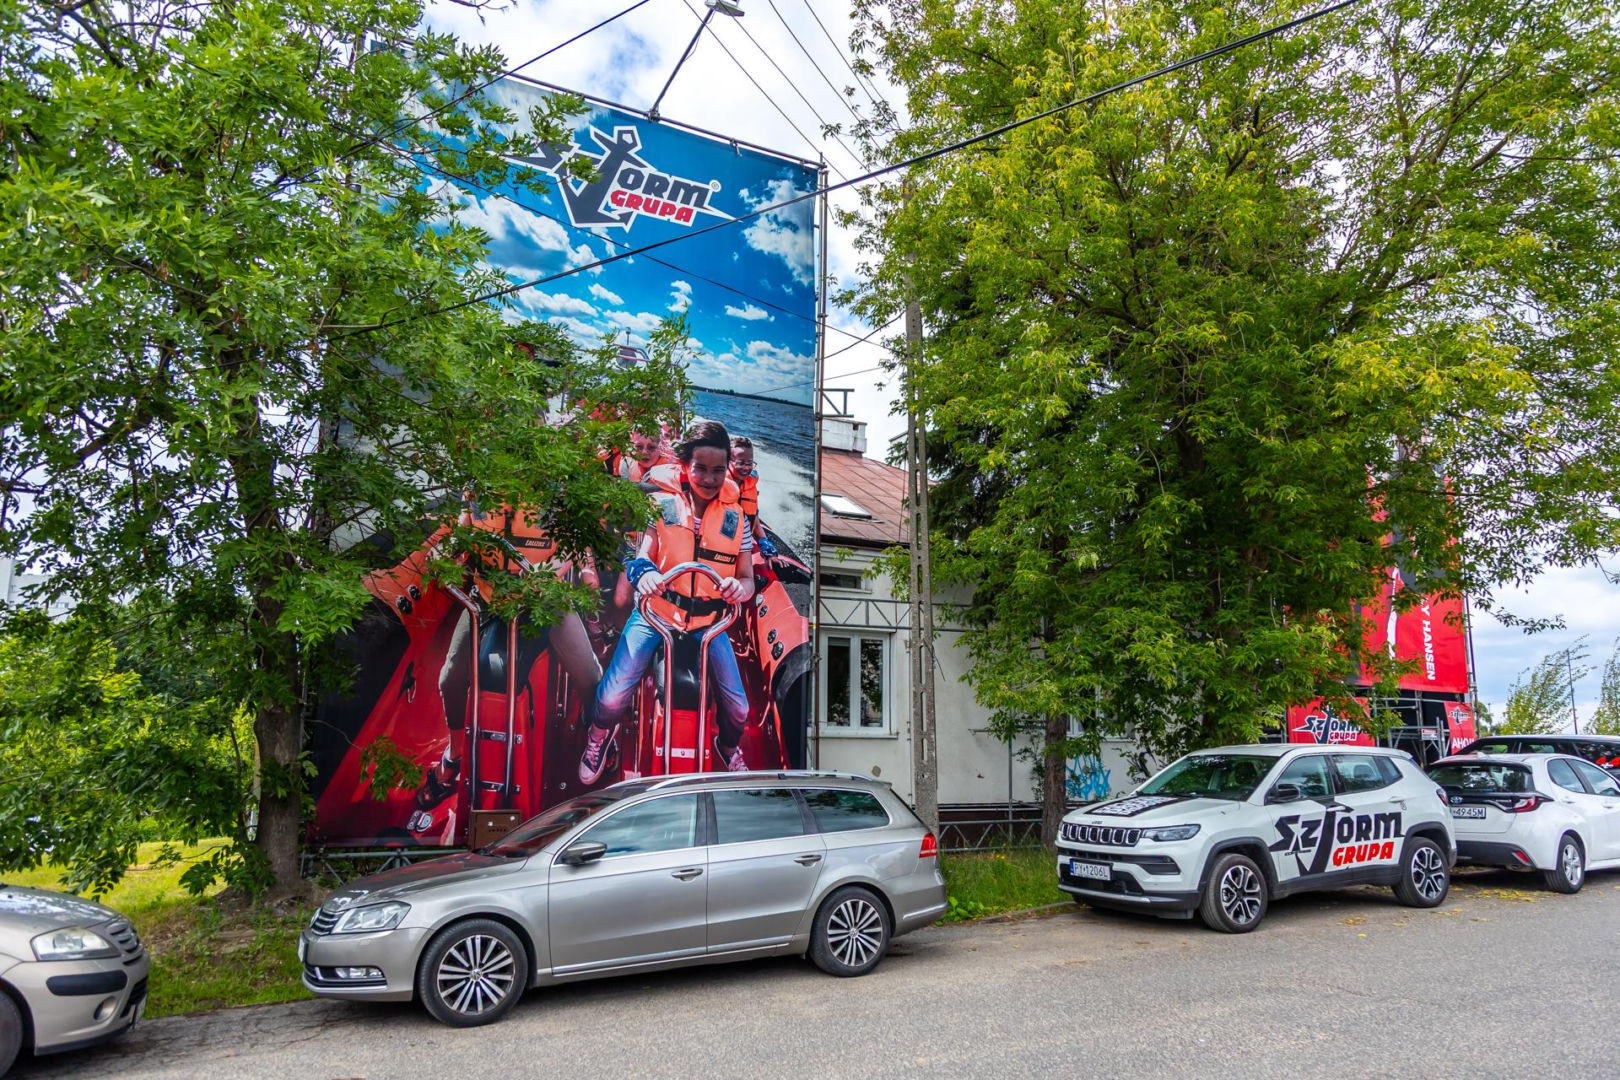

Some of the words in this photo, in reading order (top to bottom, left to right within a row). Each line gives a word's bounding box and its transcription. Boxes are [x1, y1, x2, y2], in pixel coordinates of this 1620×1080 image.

[610, 189, 694, 224] GRUPA
[1422, 620, 1436, 680] HANSEN
[1330, 732, 1356, 740] GRUPA
[1456, 808, 1483, 817] 4945M
[1268, 804, 1403, 869] SZTORM
[1332, 841, 1394, 867] GRUPA
